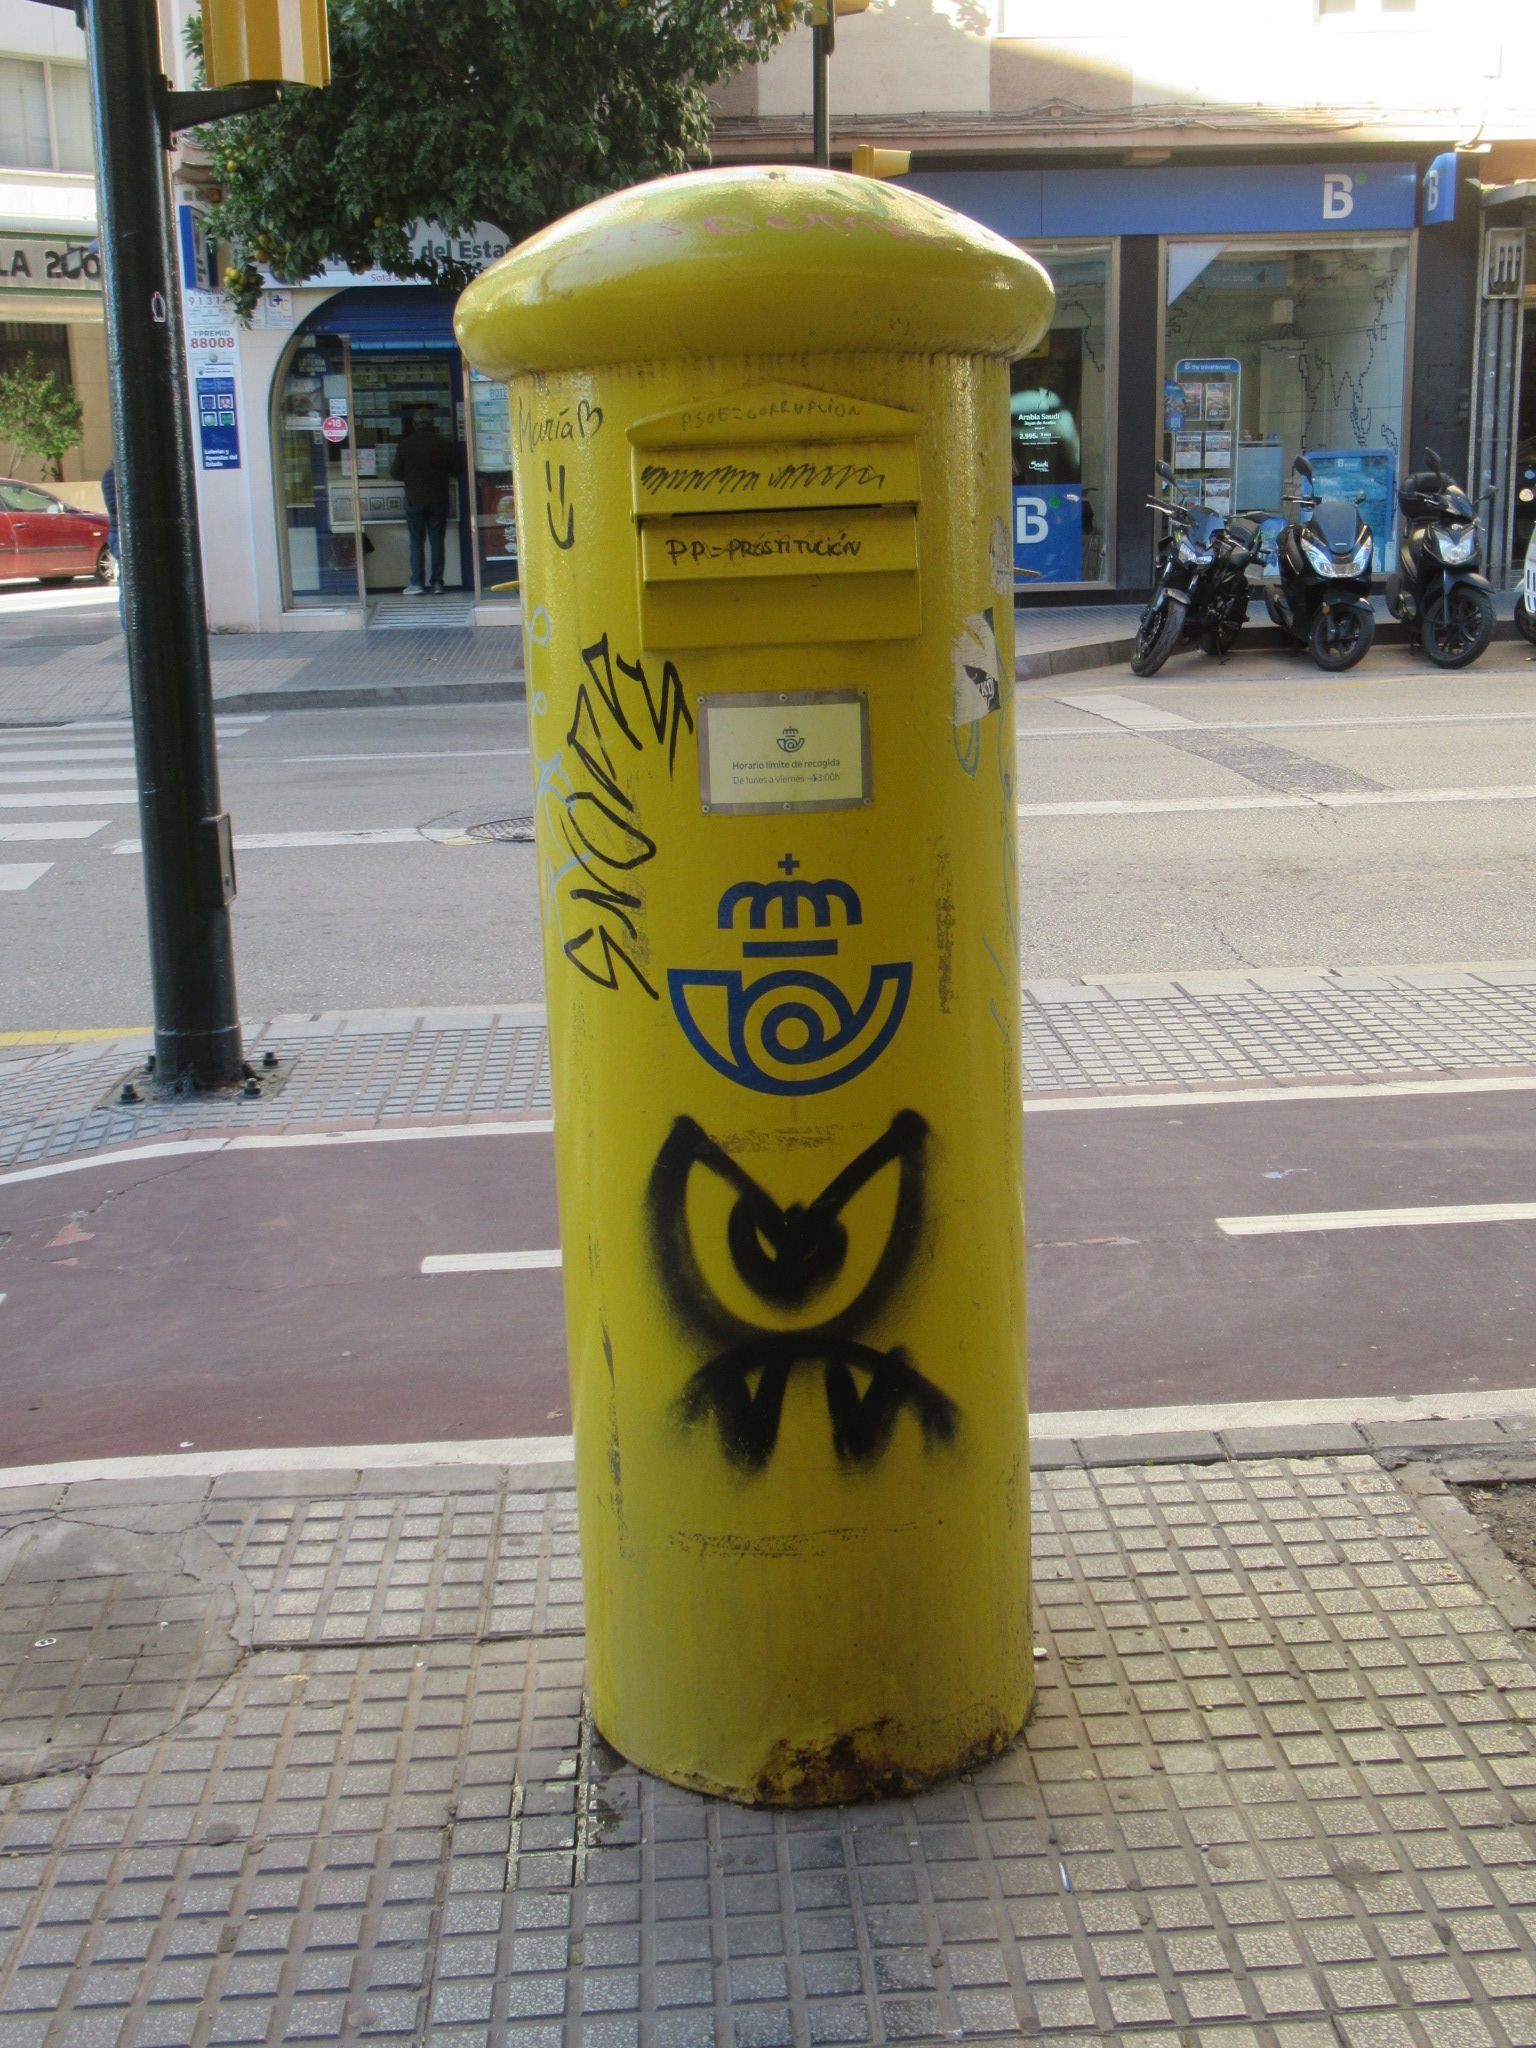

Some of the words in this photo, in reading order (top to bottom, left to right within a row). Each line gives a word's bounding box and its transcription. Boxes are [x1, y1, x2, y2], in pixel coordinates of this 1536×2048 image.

[1323, 173, 1353, 219] B
[191, 337, 235, 349] 88008
[518, 396, 574, 454] María
[1016, 497, 1049, 545] B
[732, 761, 765, 770] Horario
[791, 759, 803, 768] de
[804, 758, 841, 770] recogida
[733, 776, 745, 785] De
[745, 775, 767, 785] lunes
[775, 775, 804, 784] viernes
